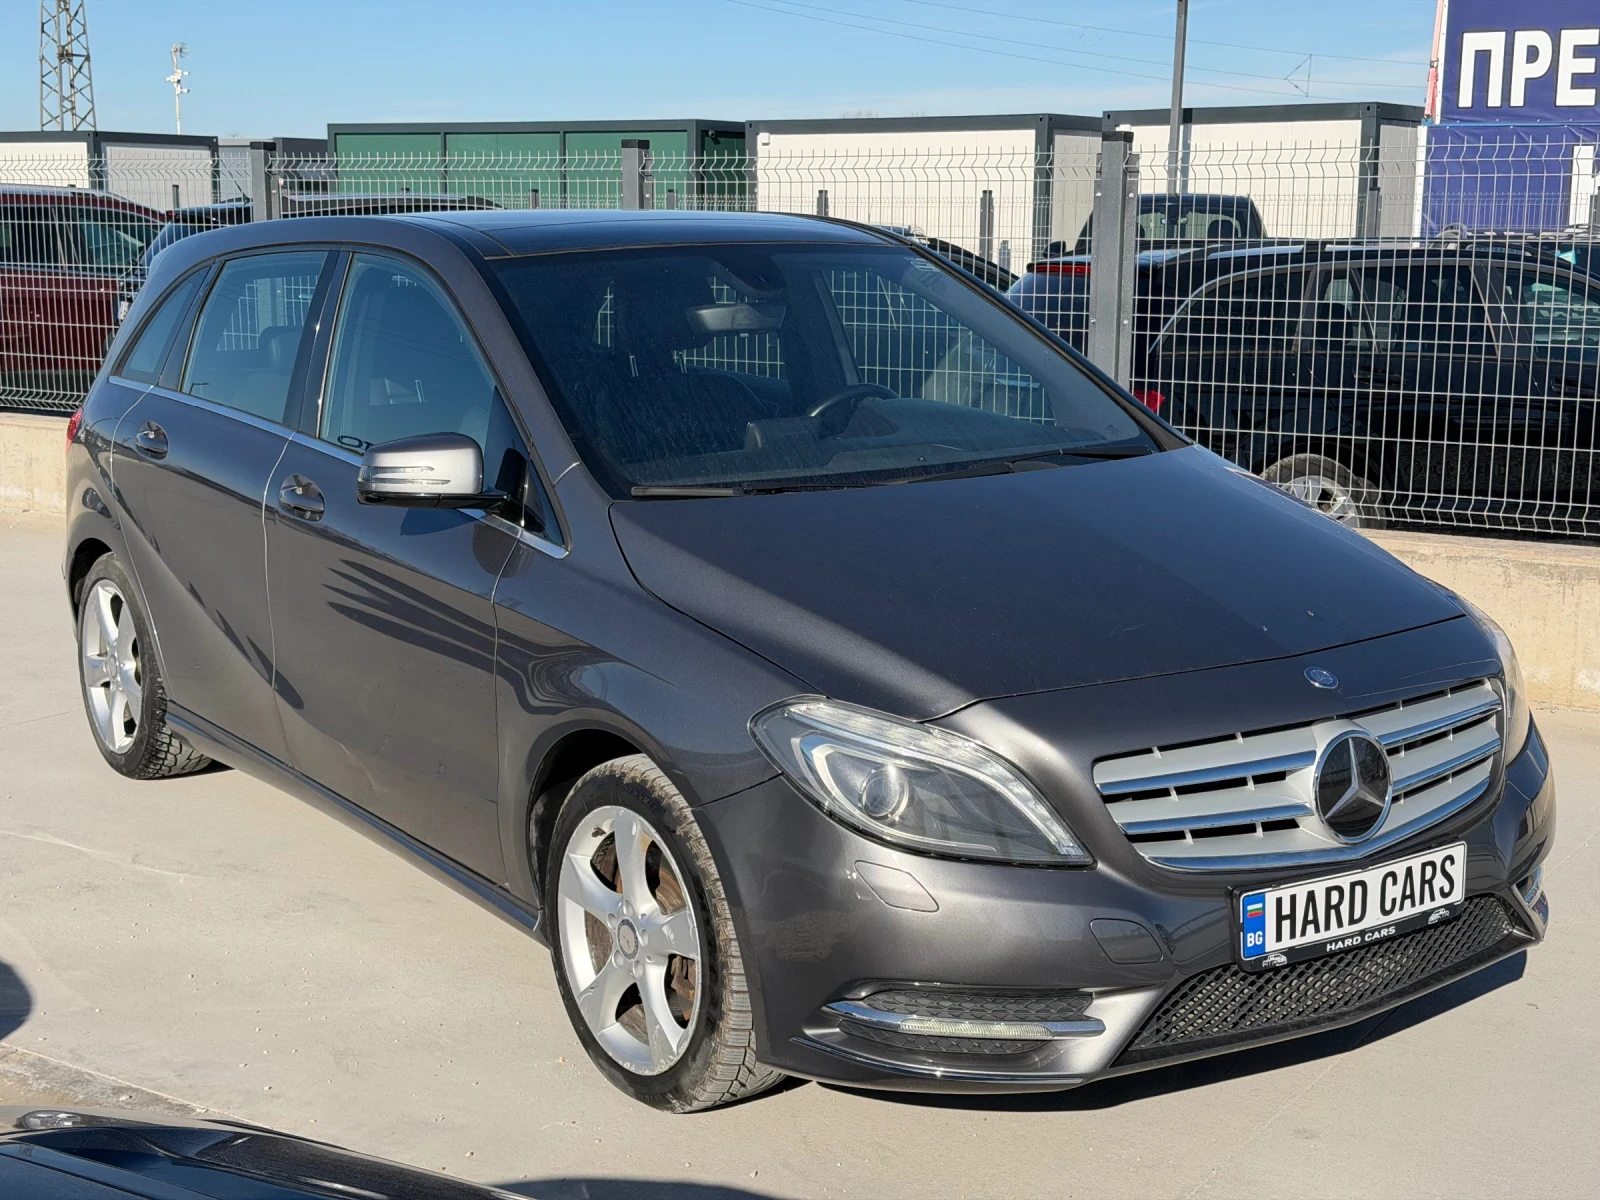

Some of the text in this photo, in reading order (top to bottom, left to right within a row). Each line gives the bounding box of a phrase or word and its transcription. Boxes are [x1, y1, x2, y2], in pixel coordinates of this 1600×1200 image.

[1458, 29, 1600, 108] ПРЕ
[1275, 854, 1455, 943] HARD CARS
[1247, 931, 1263, 947] BG
[1326, 926, 1396, 952] HARD CARS
